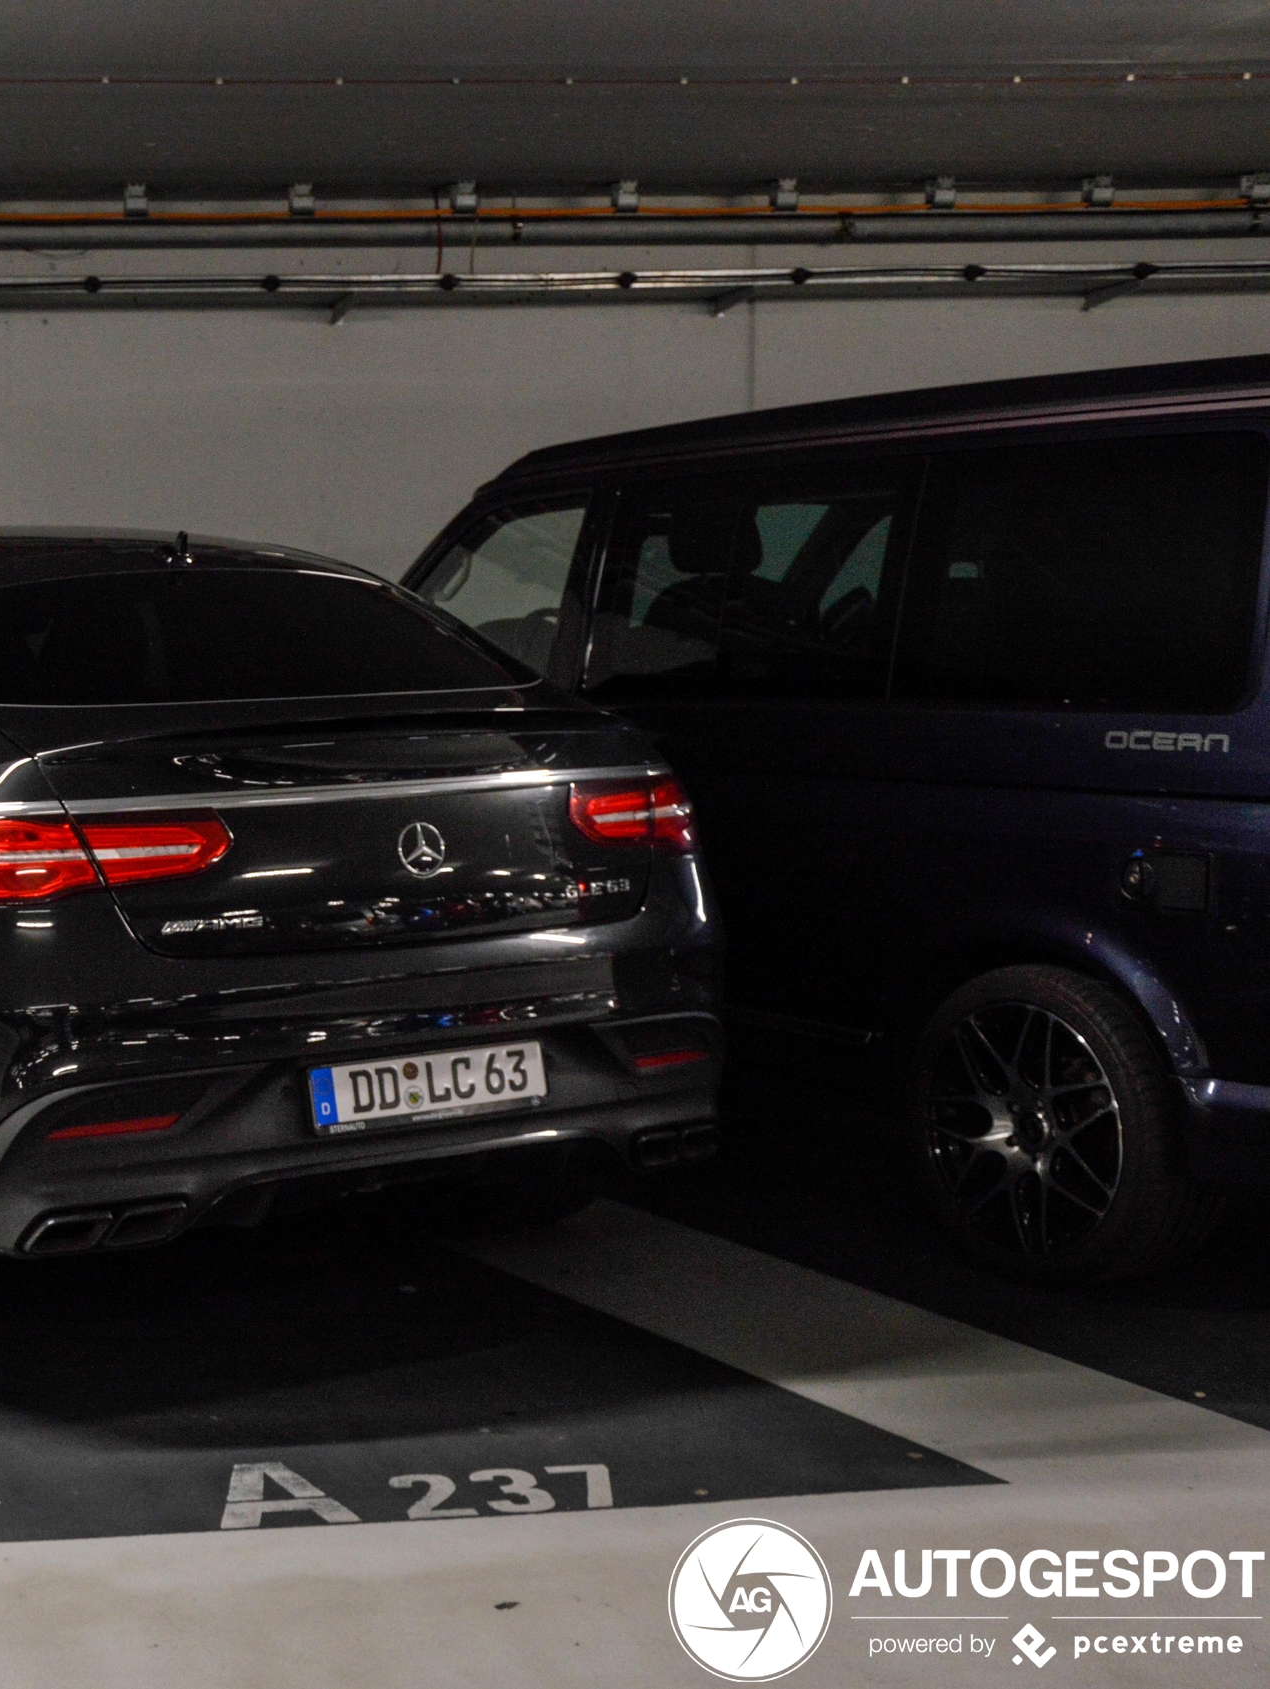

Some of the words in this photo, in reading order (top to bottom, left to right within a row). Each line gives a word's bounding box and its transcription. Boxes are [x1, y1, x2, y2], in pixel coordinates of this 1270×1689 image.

[1105, 730, 1230, 753] OCEAN
[565, 882, 604, 898] GLE
[607, 879, 629, 894] 63
[348, 1065, 401, 1114] DD
[425, 1056, 476, 1104] LC
[485, 1049, 528, 1095] 63
[321, 1102, 331, 1116] D
[329, 1121, 366, 1134] STERNAUTO
[220, 1461, 362, 1530] A
[388, 1463, 614, 1520] 237
